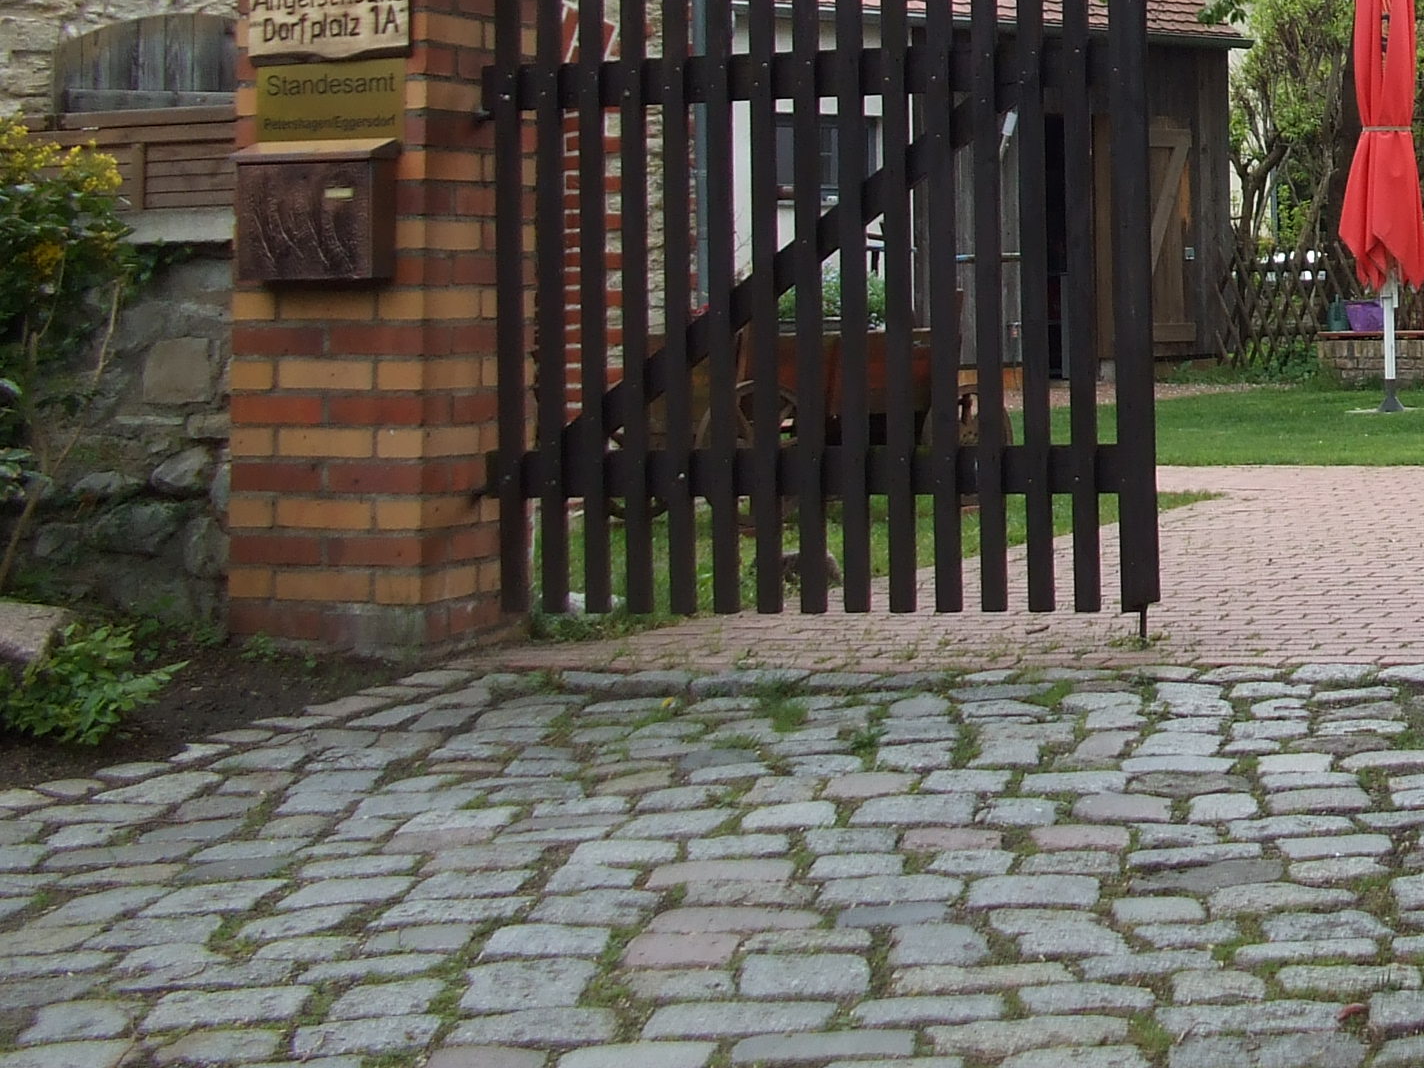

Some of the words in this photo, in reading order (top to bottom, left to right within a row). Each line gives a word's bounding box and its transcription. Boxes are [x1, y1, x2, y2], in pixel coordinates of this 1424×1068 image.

[263, 13, 361, 44] Dorfplatz
[369, 4, 400, 35] 1A
[266, 73, 396, 97] Standesamt
